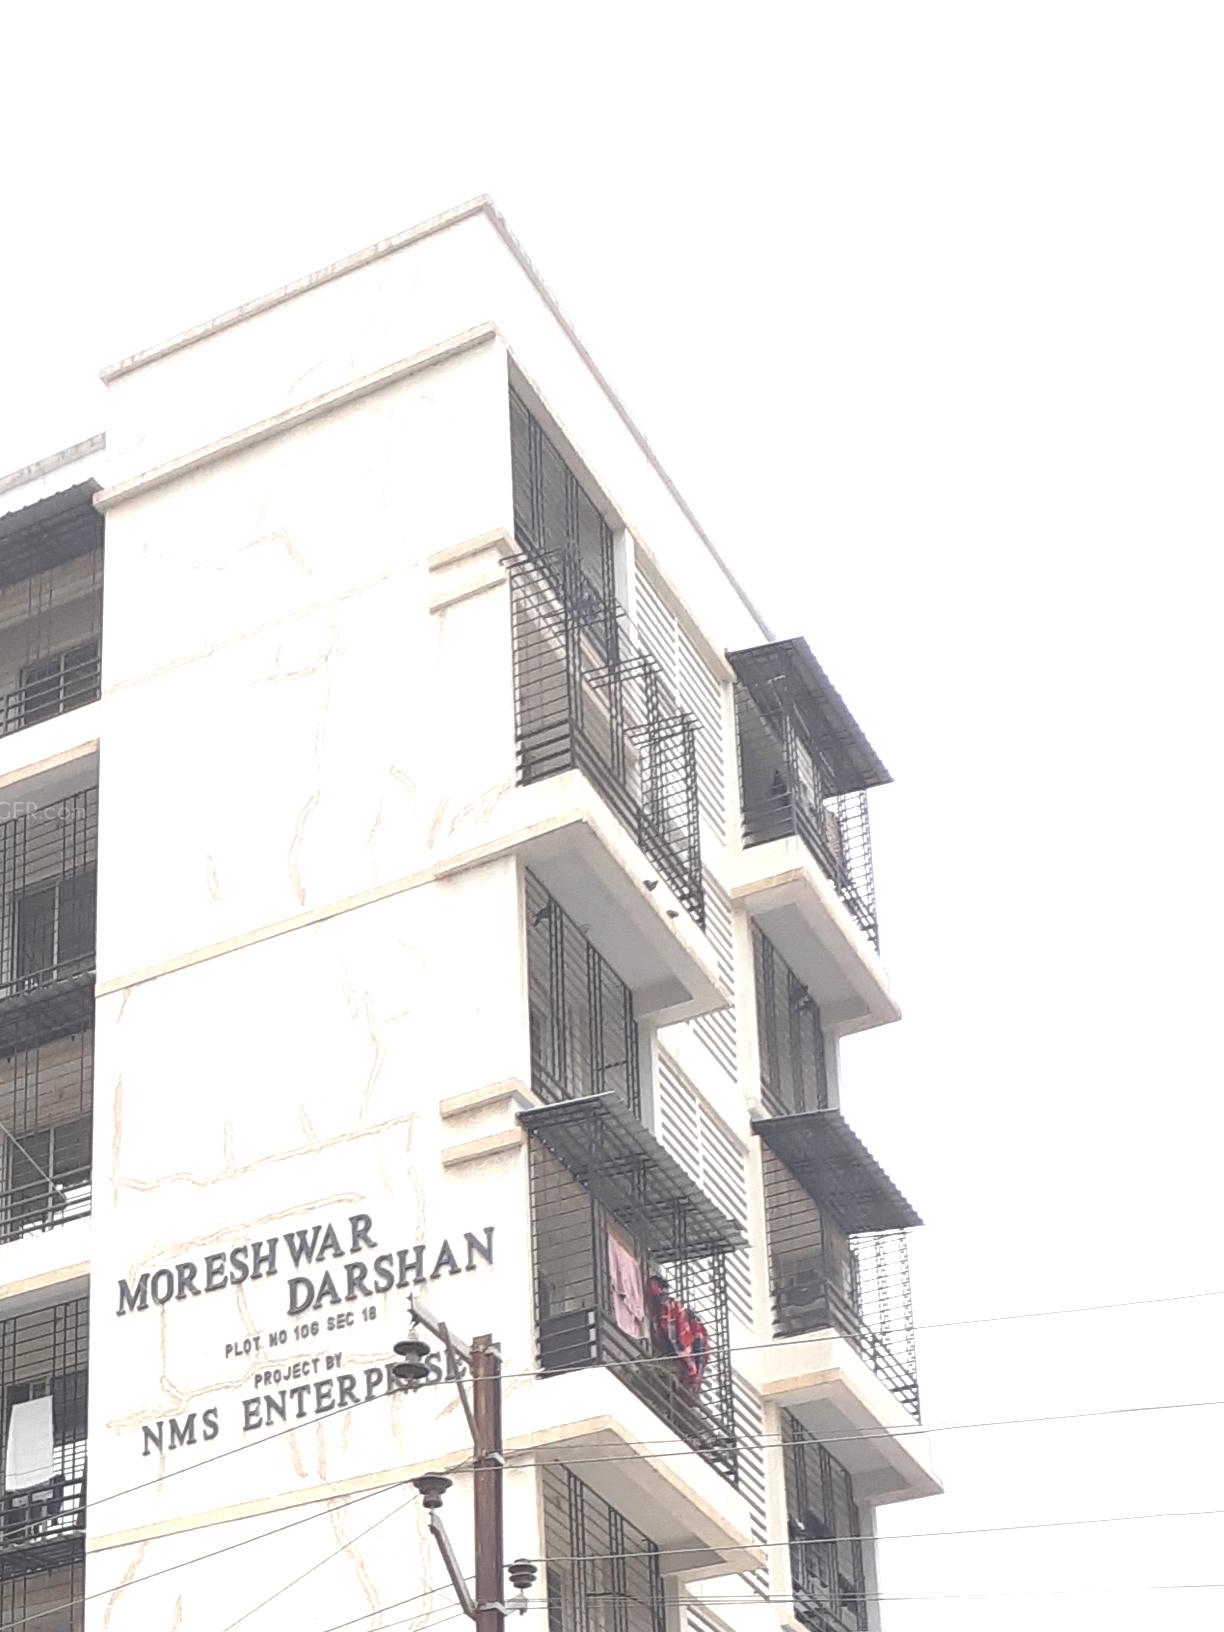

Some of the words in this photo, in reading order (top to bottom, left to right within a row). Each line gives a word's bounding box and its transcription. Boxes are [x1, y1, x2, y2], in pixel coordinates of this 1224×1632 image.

[116, 1213, 378, 1317] MORESHWAR
[286, 1226, 497, 1316] DARSHAN
[225, 1336, 262, 1358] PLOT
[294, 1321, 319, 1341] 106
[327, 1312, 354, 1332] SEC
[362, 1306, 377, 1321] 18
[254, 1358, 320, 1388] PROJECT
[325, 1352, 343, 1370] BY
[141, 1408, 220, 1456] NMS
[242, 1349, 468, 1432] ENTERPRSE
